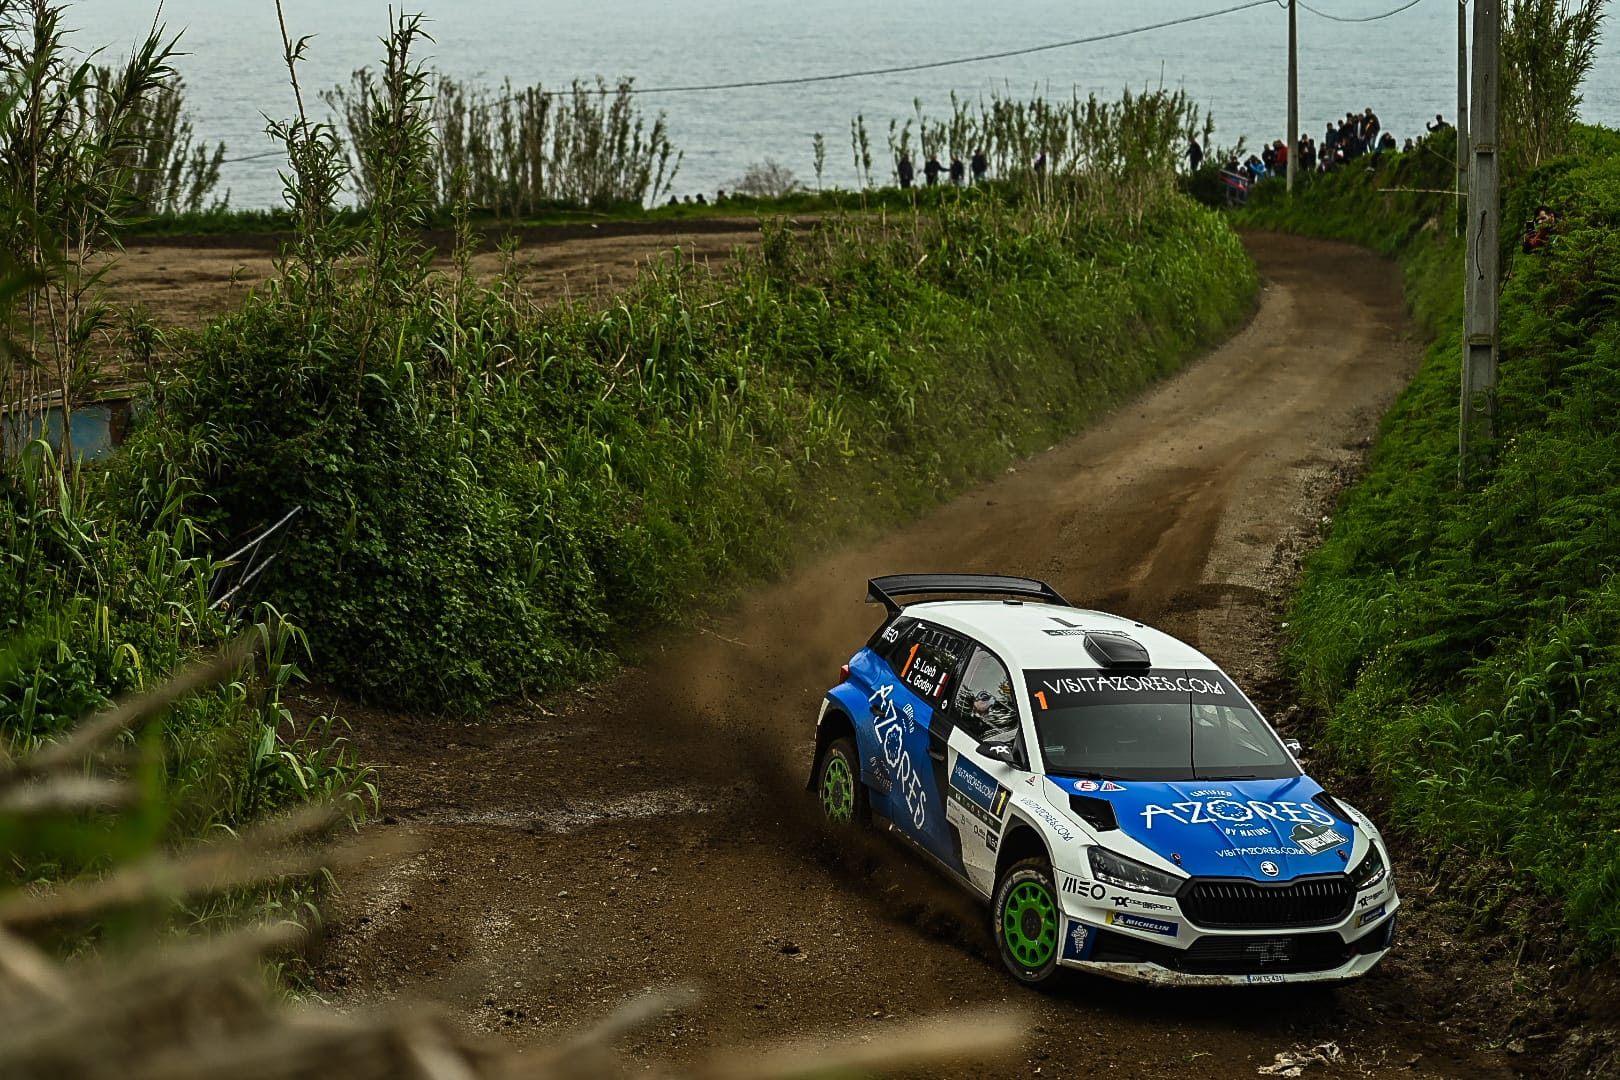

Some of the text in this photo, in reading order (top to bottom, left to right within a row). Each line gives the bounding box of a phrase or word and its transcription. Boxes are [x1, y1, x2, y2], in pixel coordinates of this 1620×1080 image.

[901, 643, 920, 678] 1
[920, 660, 937, 678] Loeb
[1043, 675, 1226, 696] VISITAZORES.COM
[1034, 690, 1049, 710] 1
[868, 684, 927, 830] AZORES
[996, 789, 1007, 816] 1
[1140, 799, 1335, 829] AZORES
[1225, 826, 1272, 837] BY NATURE
[1215, 846, 1306, 858] VISITAZORES.COM
[1062, 876, 1106, 900] MEO
[1126, 918, 1170, 931] MICHELIN
